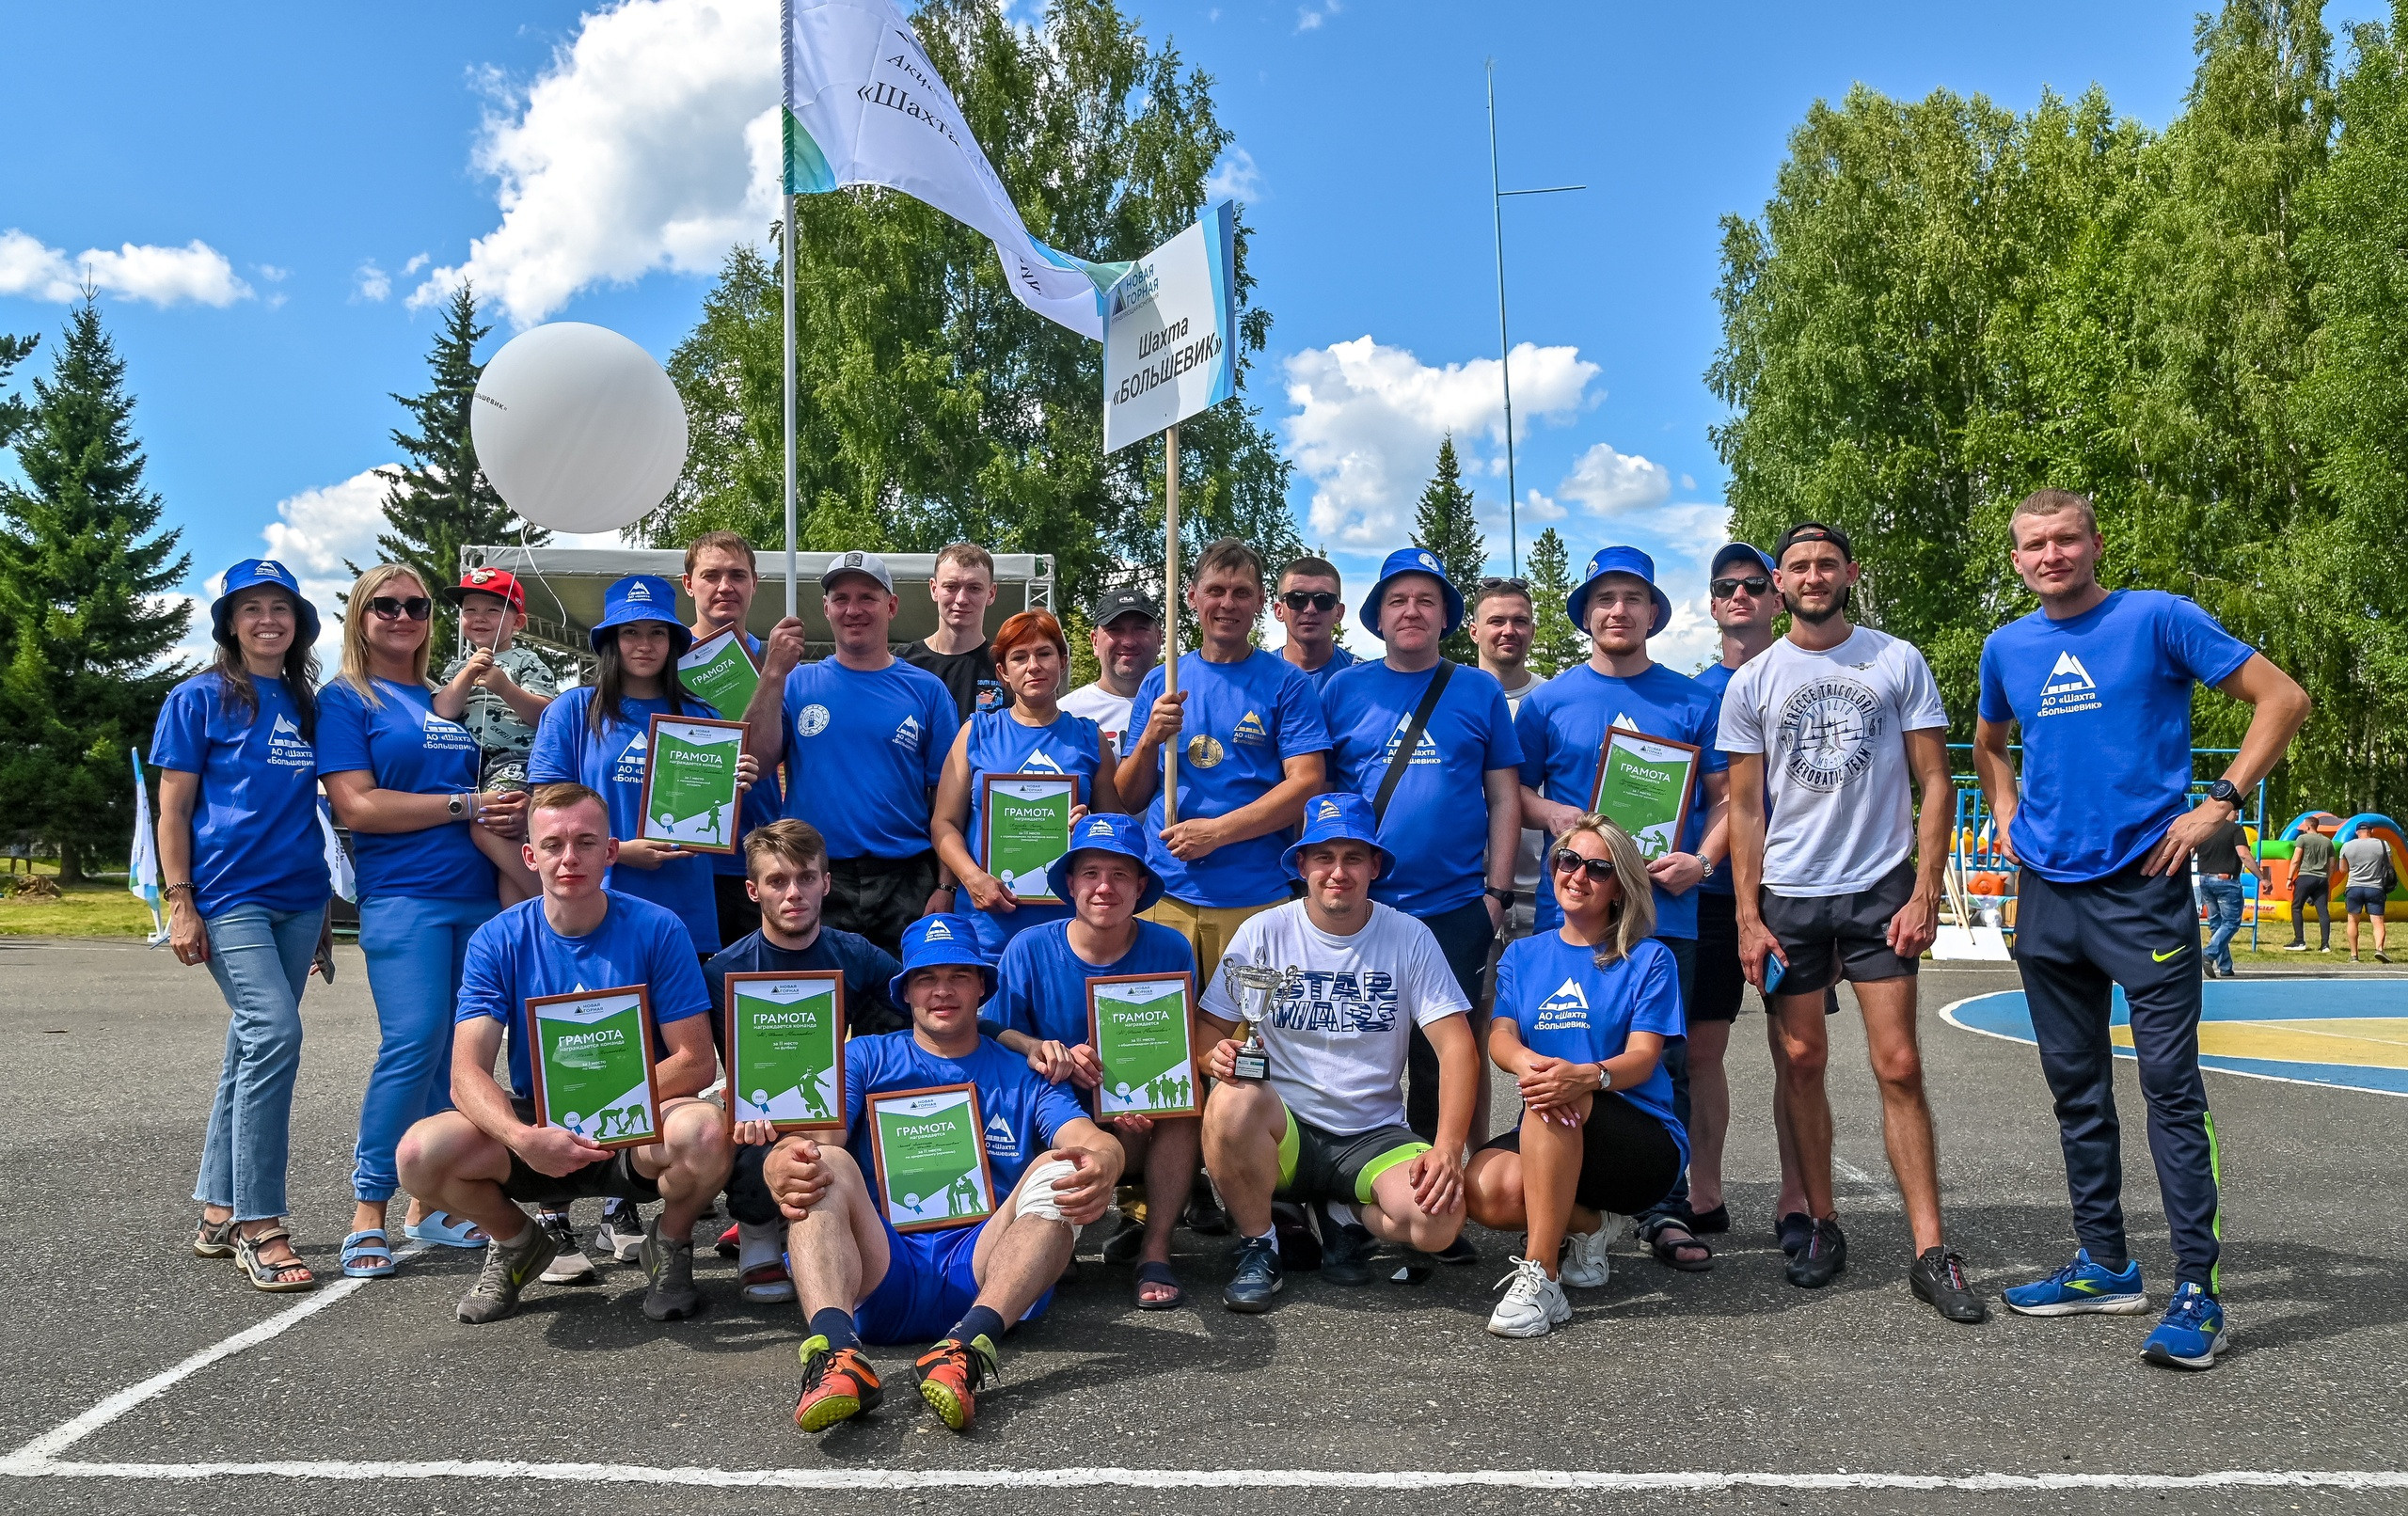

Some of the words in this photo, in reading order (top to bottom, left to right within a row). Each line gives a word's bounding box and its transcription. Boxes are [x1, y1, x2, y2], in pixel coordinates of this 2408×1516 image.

[1126, 263, 1154, 292] НОВАЯ
[1126, 277, 1159, 308] ГОРНАЯ
[1138, 317, 1189, 360] Шахта
[1113, 331, 1223, 406] «БОЛЬШЕВИК»
[691, 658, 736, 687] ГРАМОТА
[1784, 687, 1819, 728] FRECCE
[1819, 684, 1876, 716] TRICOLORI
[2041, 696, 2057, 707] АО
[2058, 692, 2096, 704] «Шахта
[2036, 702, 2103, 718] «Большевик»
[440, 734, 471, 743] «Шахта
[271, 747, 283, 756] АО
[670, 750, 723, 764] ГРАМОТА
[617, 765, 633, 774] АО
[1620, 762, 1671, 783] ГРАМОТА
[1790, 757, 1845, 786] AEROBATIC
[1845, 747, 1873, 776] TEAM
[1004, 808, 1055, 817] ГРАМОТА
[1274, 971, 1399, 1003] STAR
[753, 1012, 816, 1024] ГРАМОТА
[1113, 1011, 1170, 1024] ГРАМОТА
[1271, 1000, 1399, 1033] WARS
[1538, 1011, 1553, 1020] АО
[1554, 1011, 1588, 1020] «Шахта
[1533, 1020, 1592, 1031] «Большевик»
[558, 1029, 624, 1047] ГРАМОТА
[559, 1043, 599, 1051] награждается
[895, 1121, 957, 1137] ГРАМОТА
